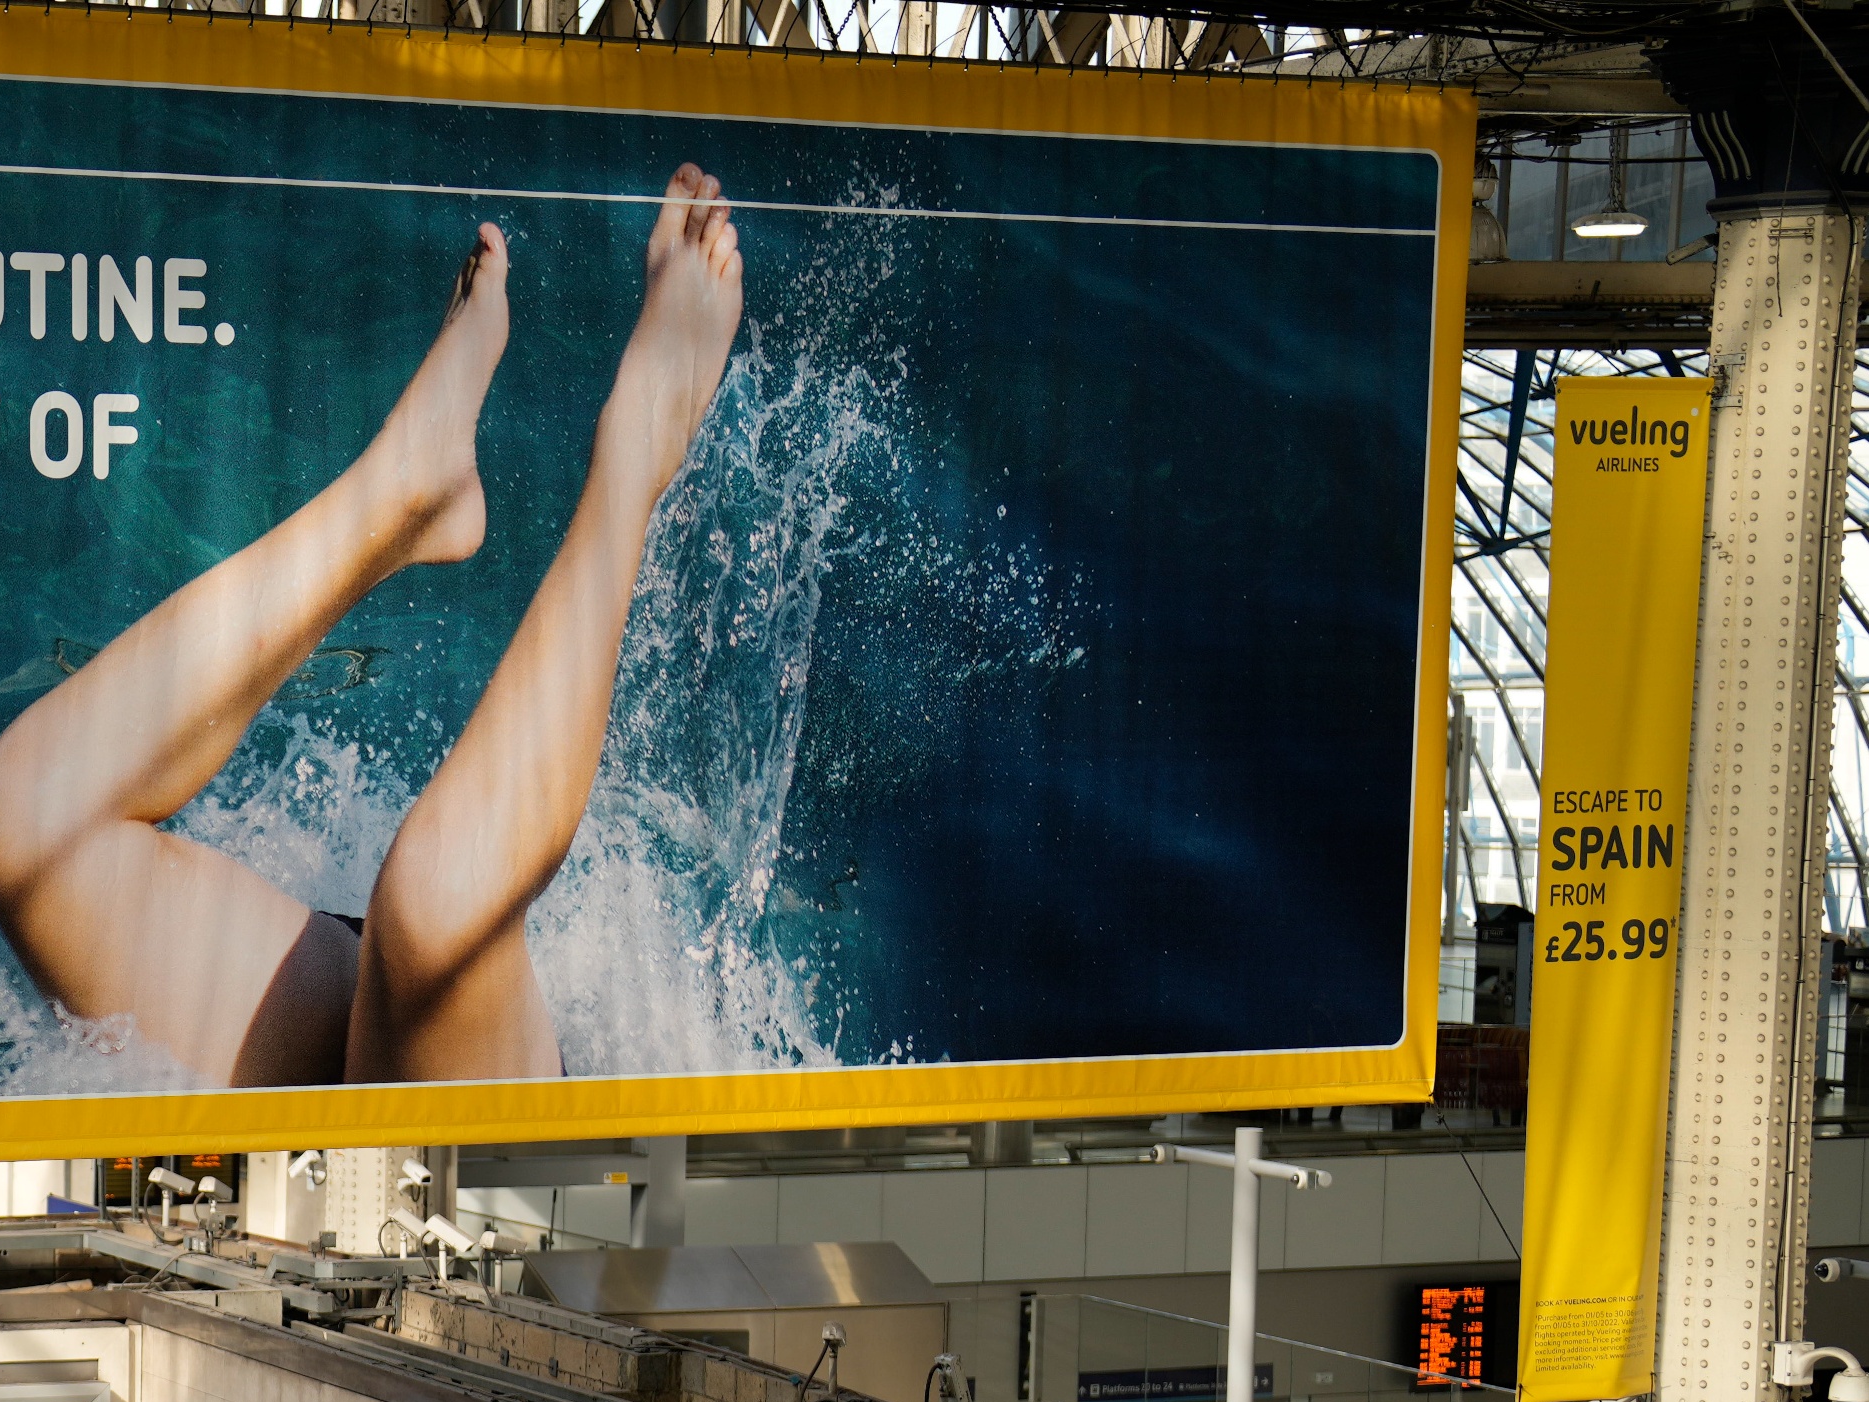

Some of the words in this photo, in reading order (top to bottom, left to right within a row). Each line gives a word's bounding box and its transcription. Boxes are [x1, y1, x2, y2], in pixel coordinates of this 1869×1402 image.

[27, 391, 140, 481] OF
[1570, 406, 1690, 458] vueling
[1595, 457, 1660, 473] AIRLINES
[1554, 790, 1629, 814] ESCAPE
[1634, 789, 1663, 812] TO
[1552, 823, 1674, 872] SPAIN
[1550, 882, 1606, 907] FROM
